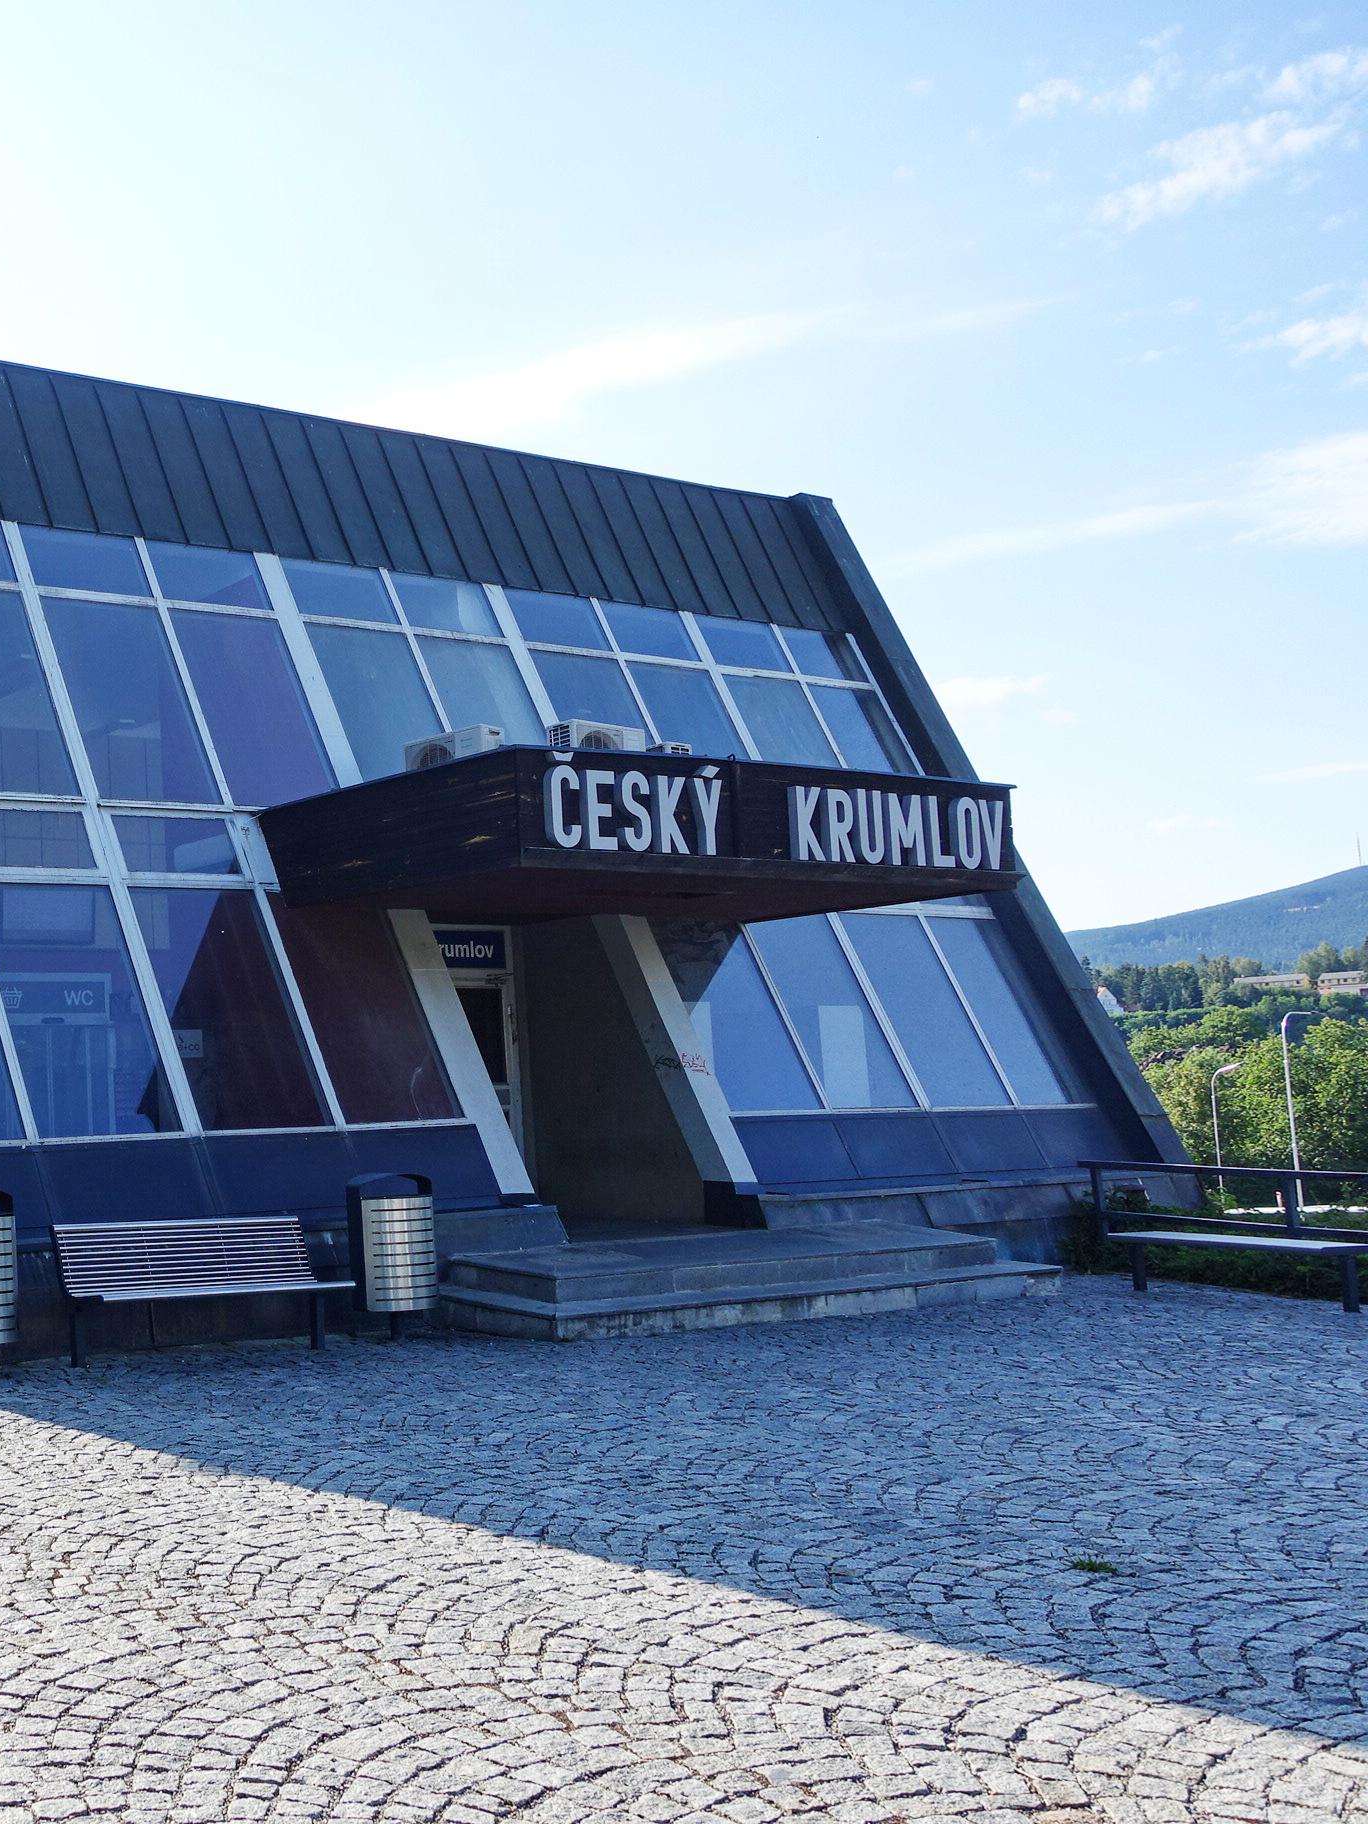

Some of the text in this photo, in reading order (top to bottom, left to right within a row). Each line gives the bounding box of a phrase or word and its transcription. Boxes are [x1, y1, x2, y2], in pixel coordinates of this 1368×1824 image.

[545, 751, 1004, 871] ČESKÝ KRUMLOV
[438, 940, 494, 958] rumlov
[64, 989, 94, 1007] WC
